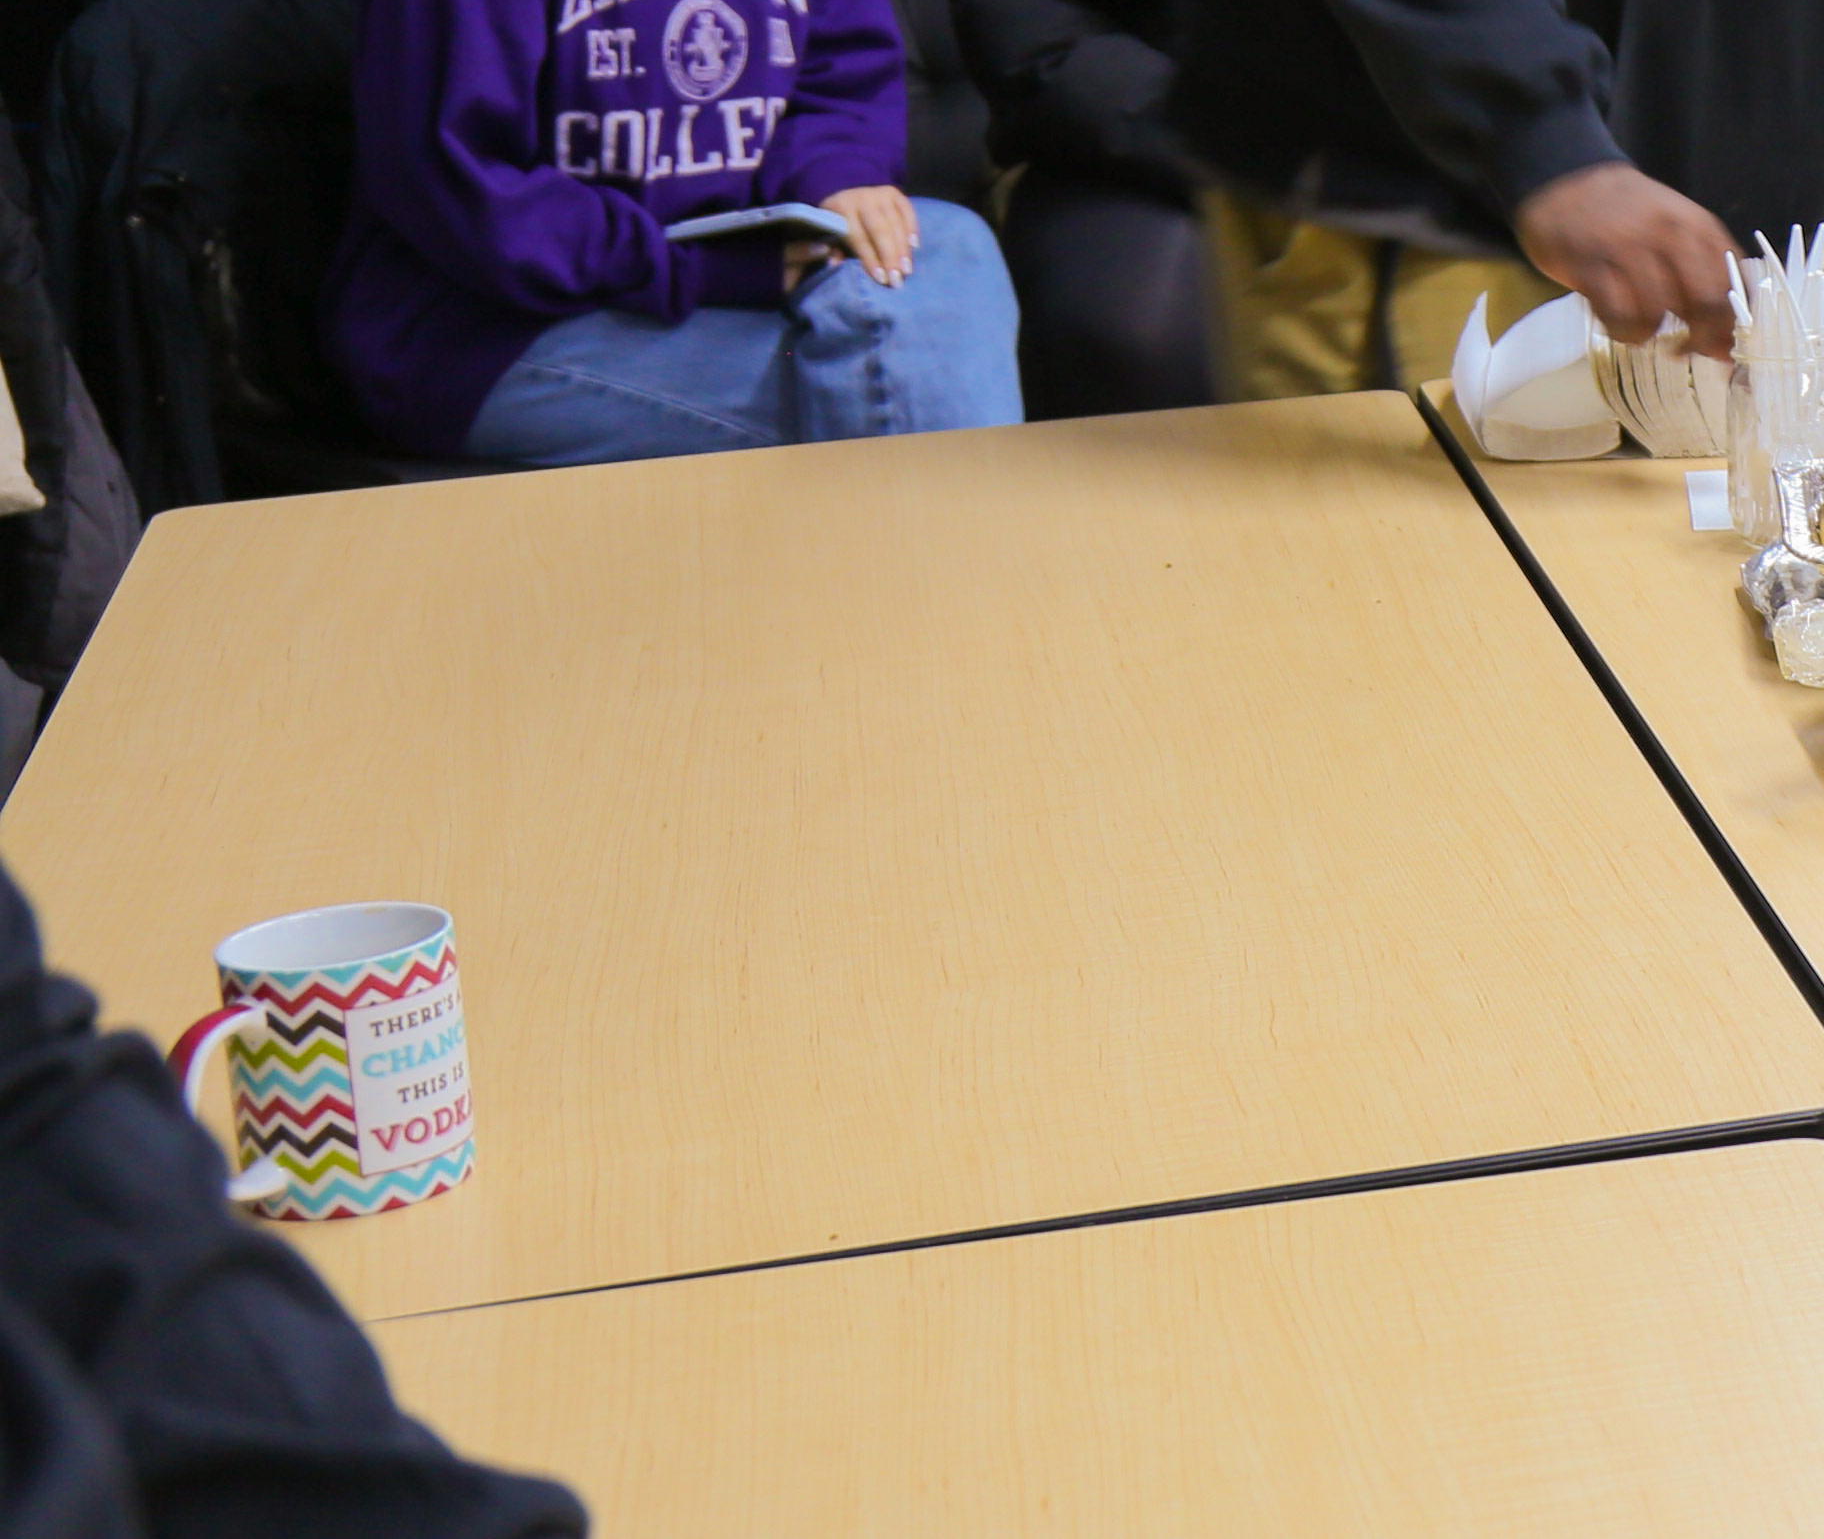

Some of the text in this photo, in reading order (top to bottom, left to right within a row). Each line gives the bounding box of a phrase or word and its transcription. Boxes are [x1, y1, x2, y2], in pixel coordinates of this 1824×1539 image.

[587, 27, 647, 79] EST.
[370, 993, 453, 1037] THERE'S
[397, 1061, 464, 1103] THIS IS
